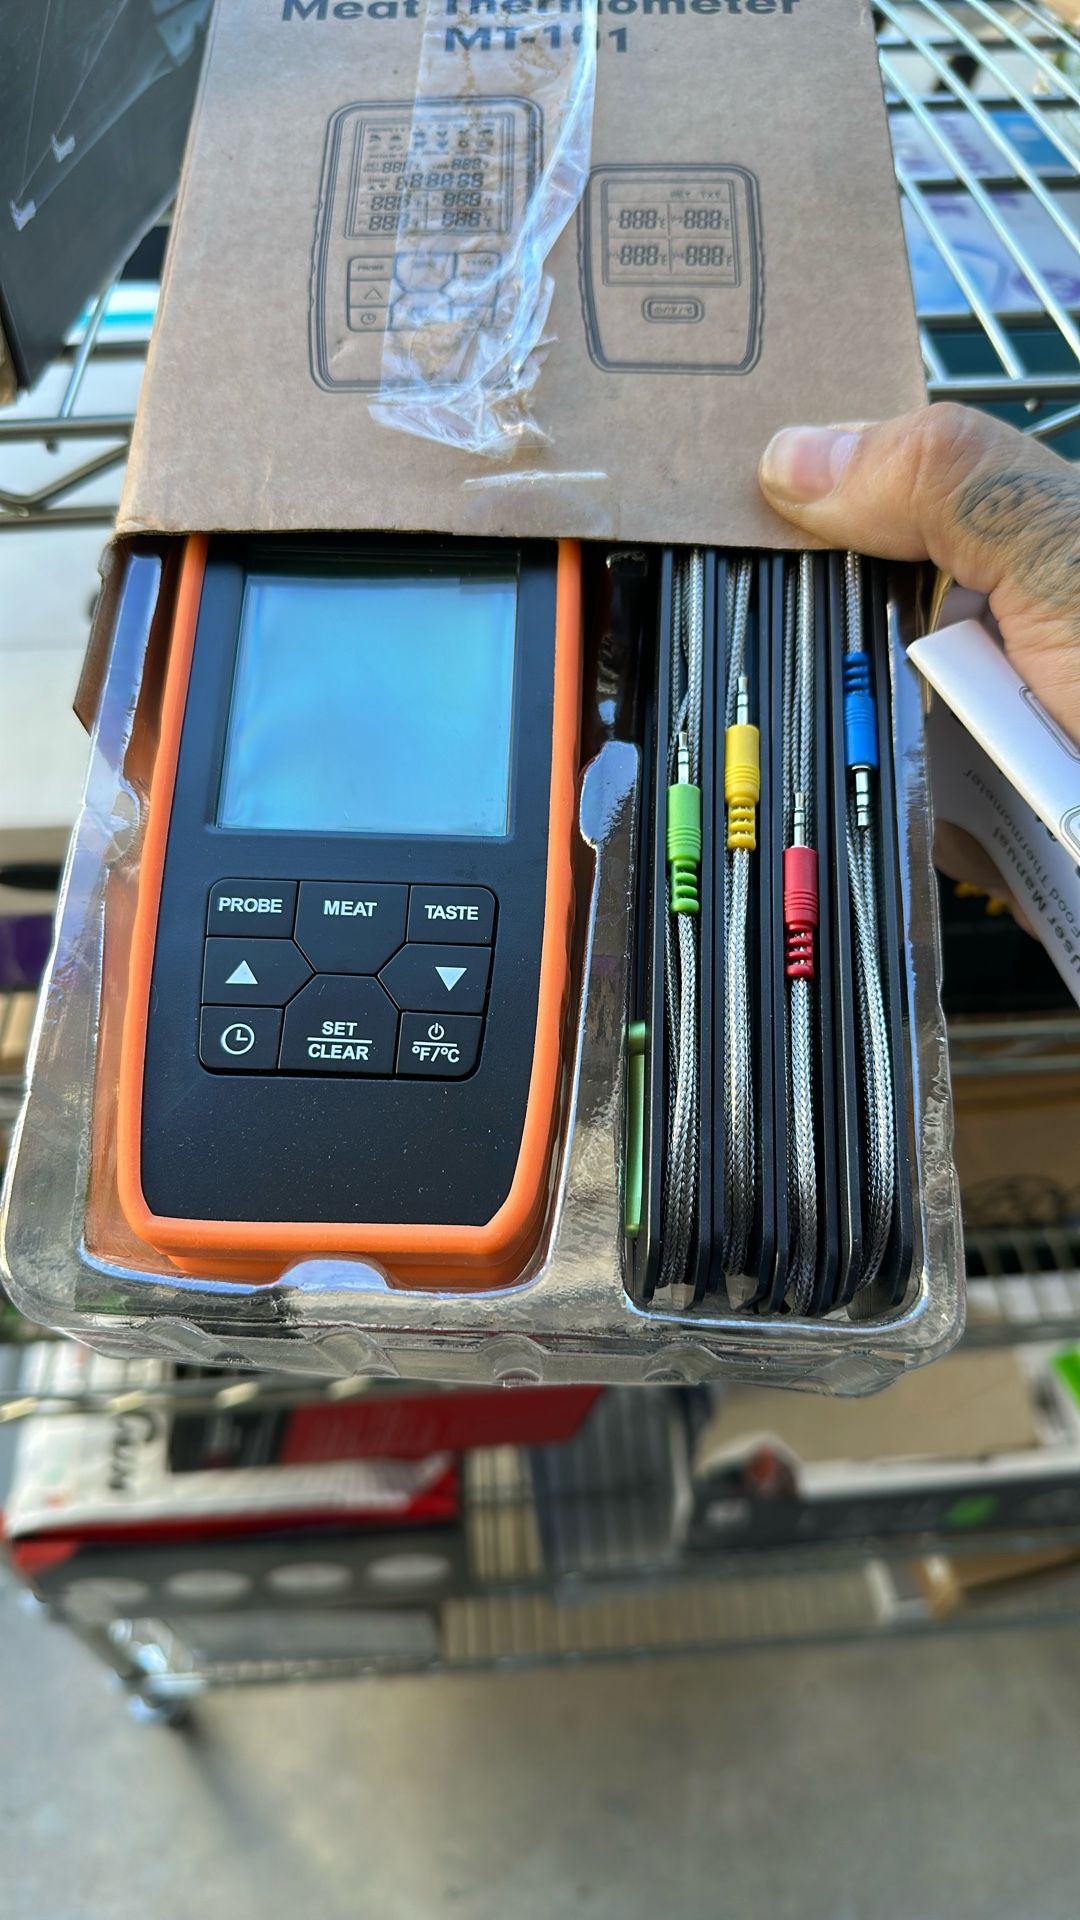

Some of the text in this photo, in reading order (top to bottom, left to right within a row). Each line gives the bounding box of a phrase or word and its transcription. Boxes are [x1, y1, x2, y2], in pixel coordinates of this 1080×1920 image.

[281, 0, 419, 21] Meat
[962, 768, 1080, 939] Food Thermometer
[992, 826, 1047, 912] Manual
[218, 897, 283, 914] PROBE
[323, 900, 378, 917] MEAT
[424, 904, 479, 921] TASTE
[321, 1020, 358, 1036] SET
[307, 1044, 369, 1061] CLEAR
[411, 1046, 460, 1064] °F/°C
